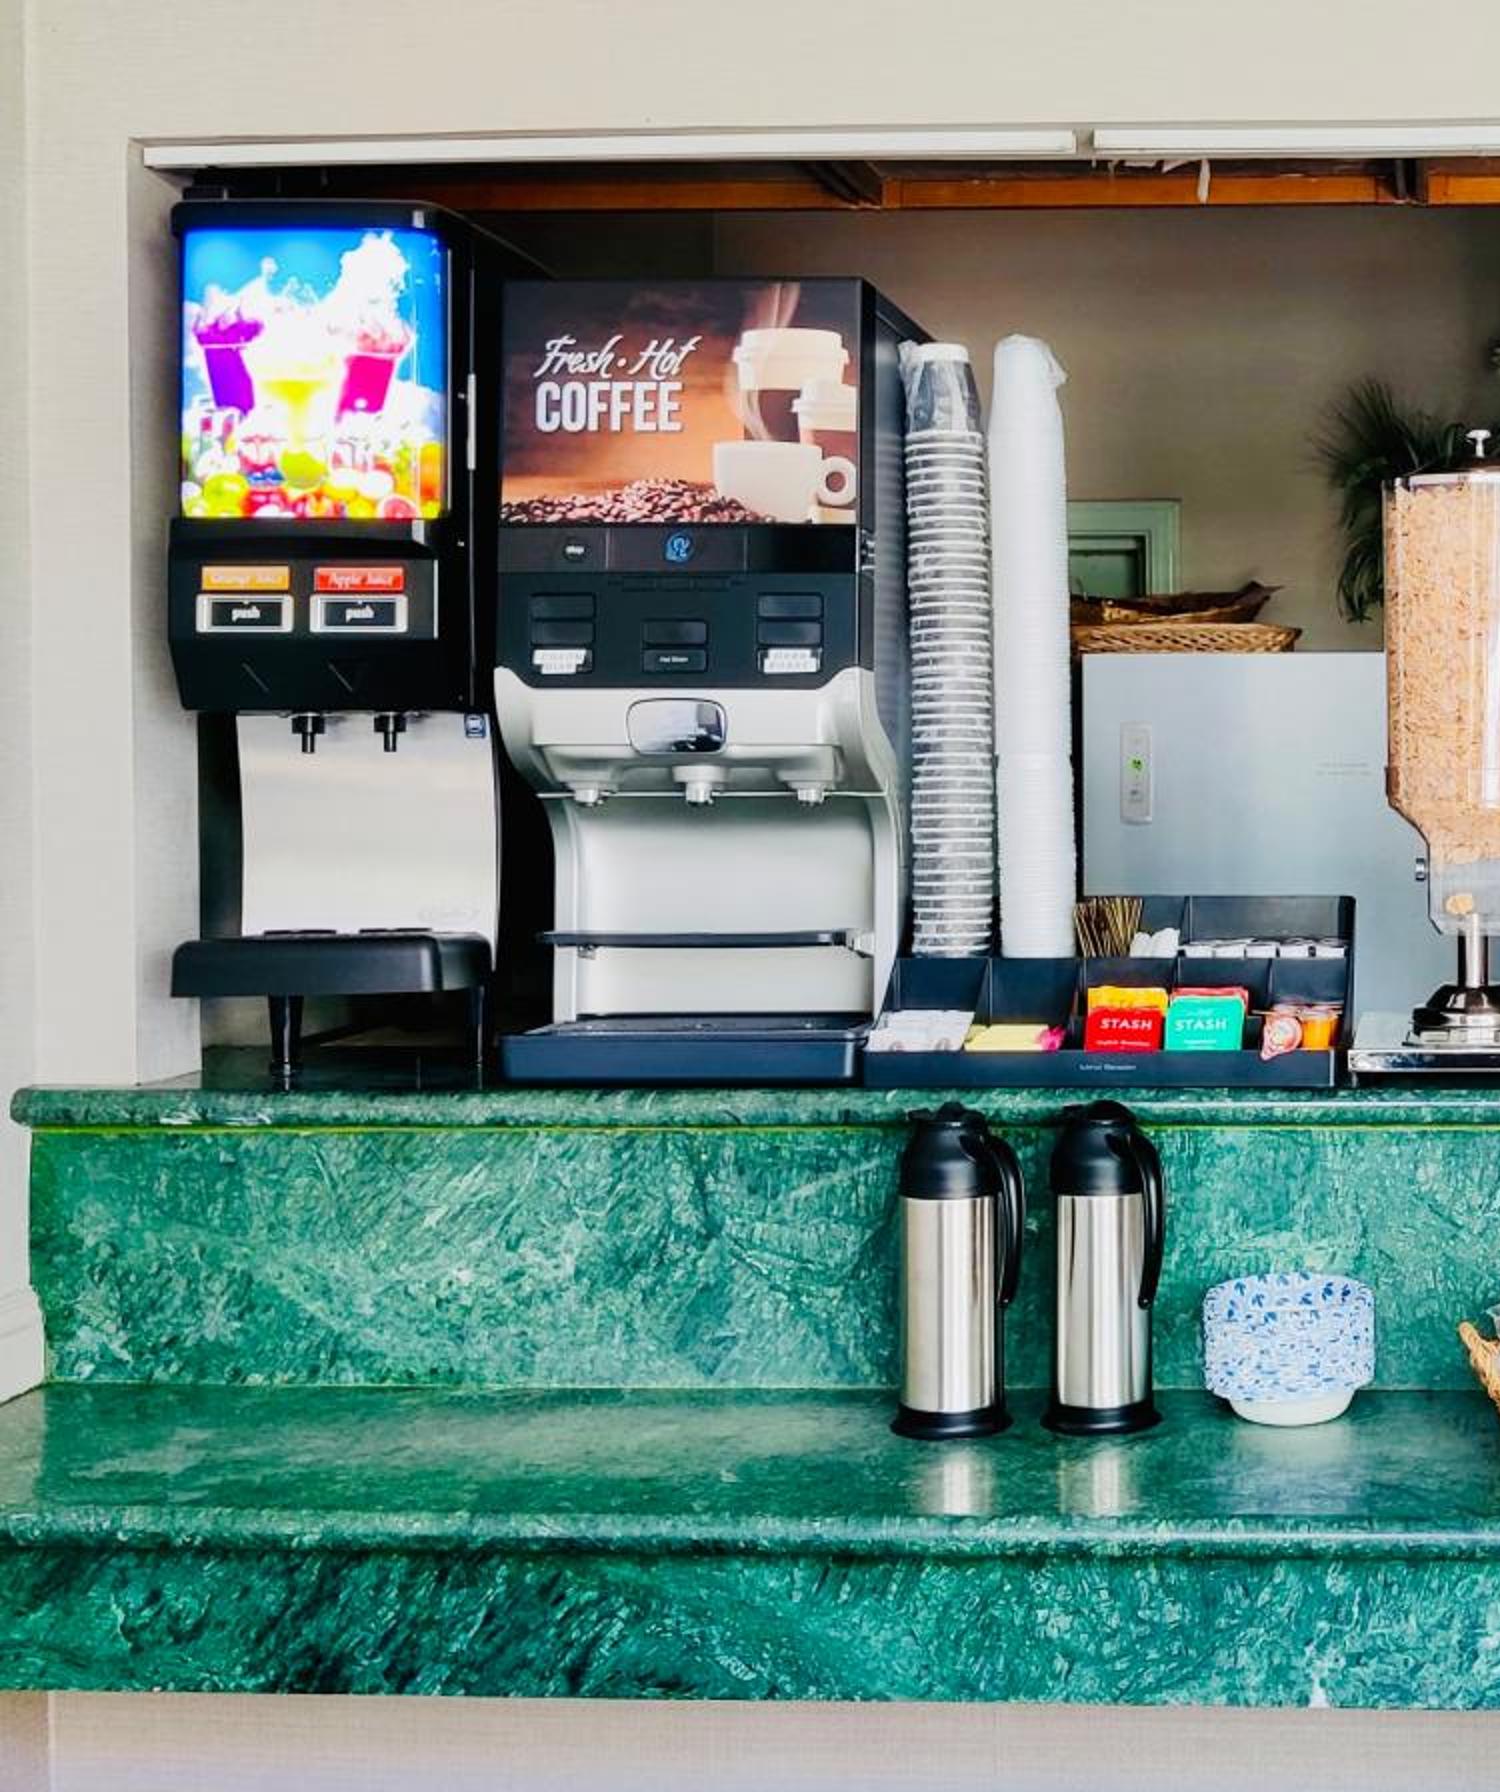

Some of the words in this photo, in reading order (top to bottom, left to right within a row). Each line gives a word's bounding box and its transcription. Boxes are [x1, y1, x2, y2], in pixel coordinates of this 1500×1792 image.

[533, 334, 623, 378] Fresh
[627, 335, 702, 380] Hot
[535, 381, 684, 432] COFFEE
[231, 606, 261, 622] push
[345, 606, 375, 622] push
[1100, 1018, 1152, 1030] STASH
[1175, 1018, 1227, 1030] STASH
